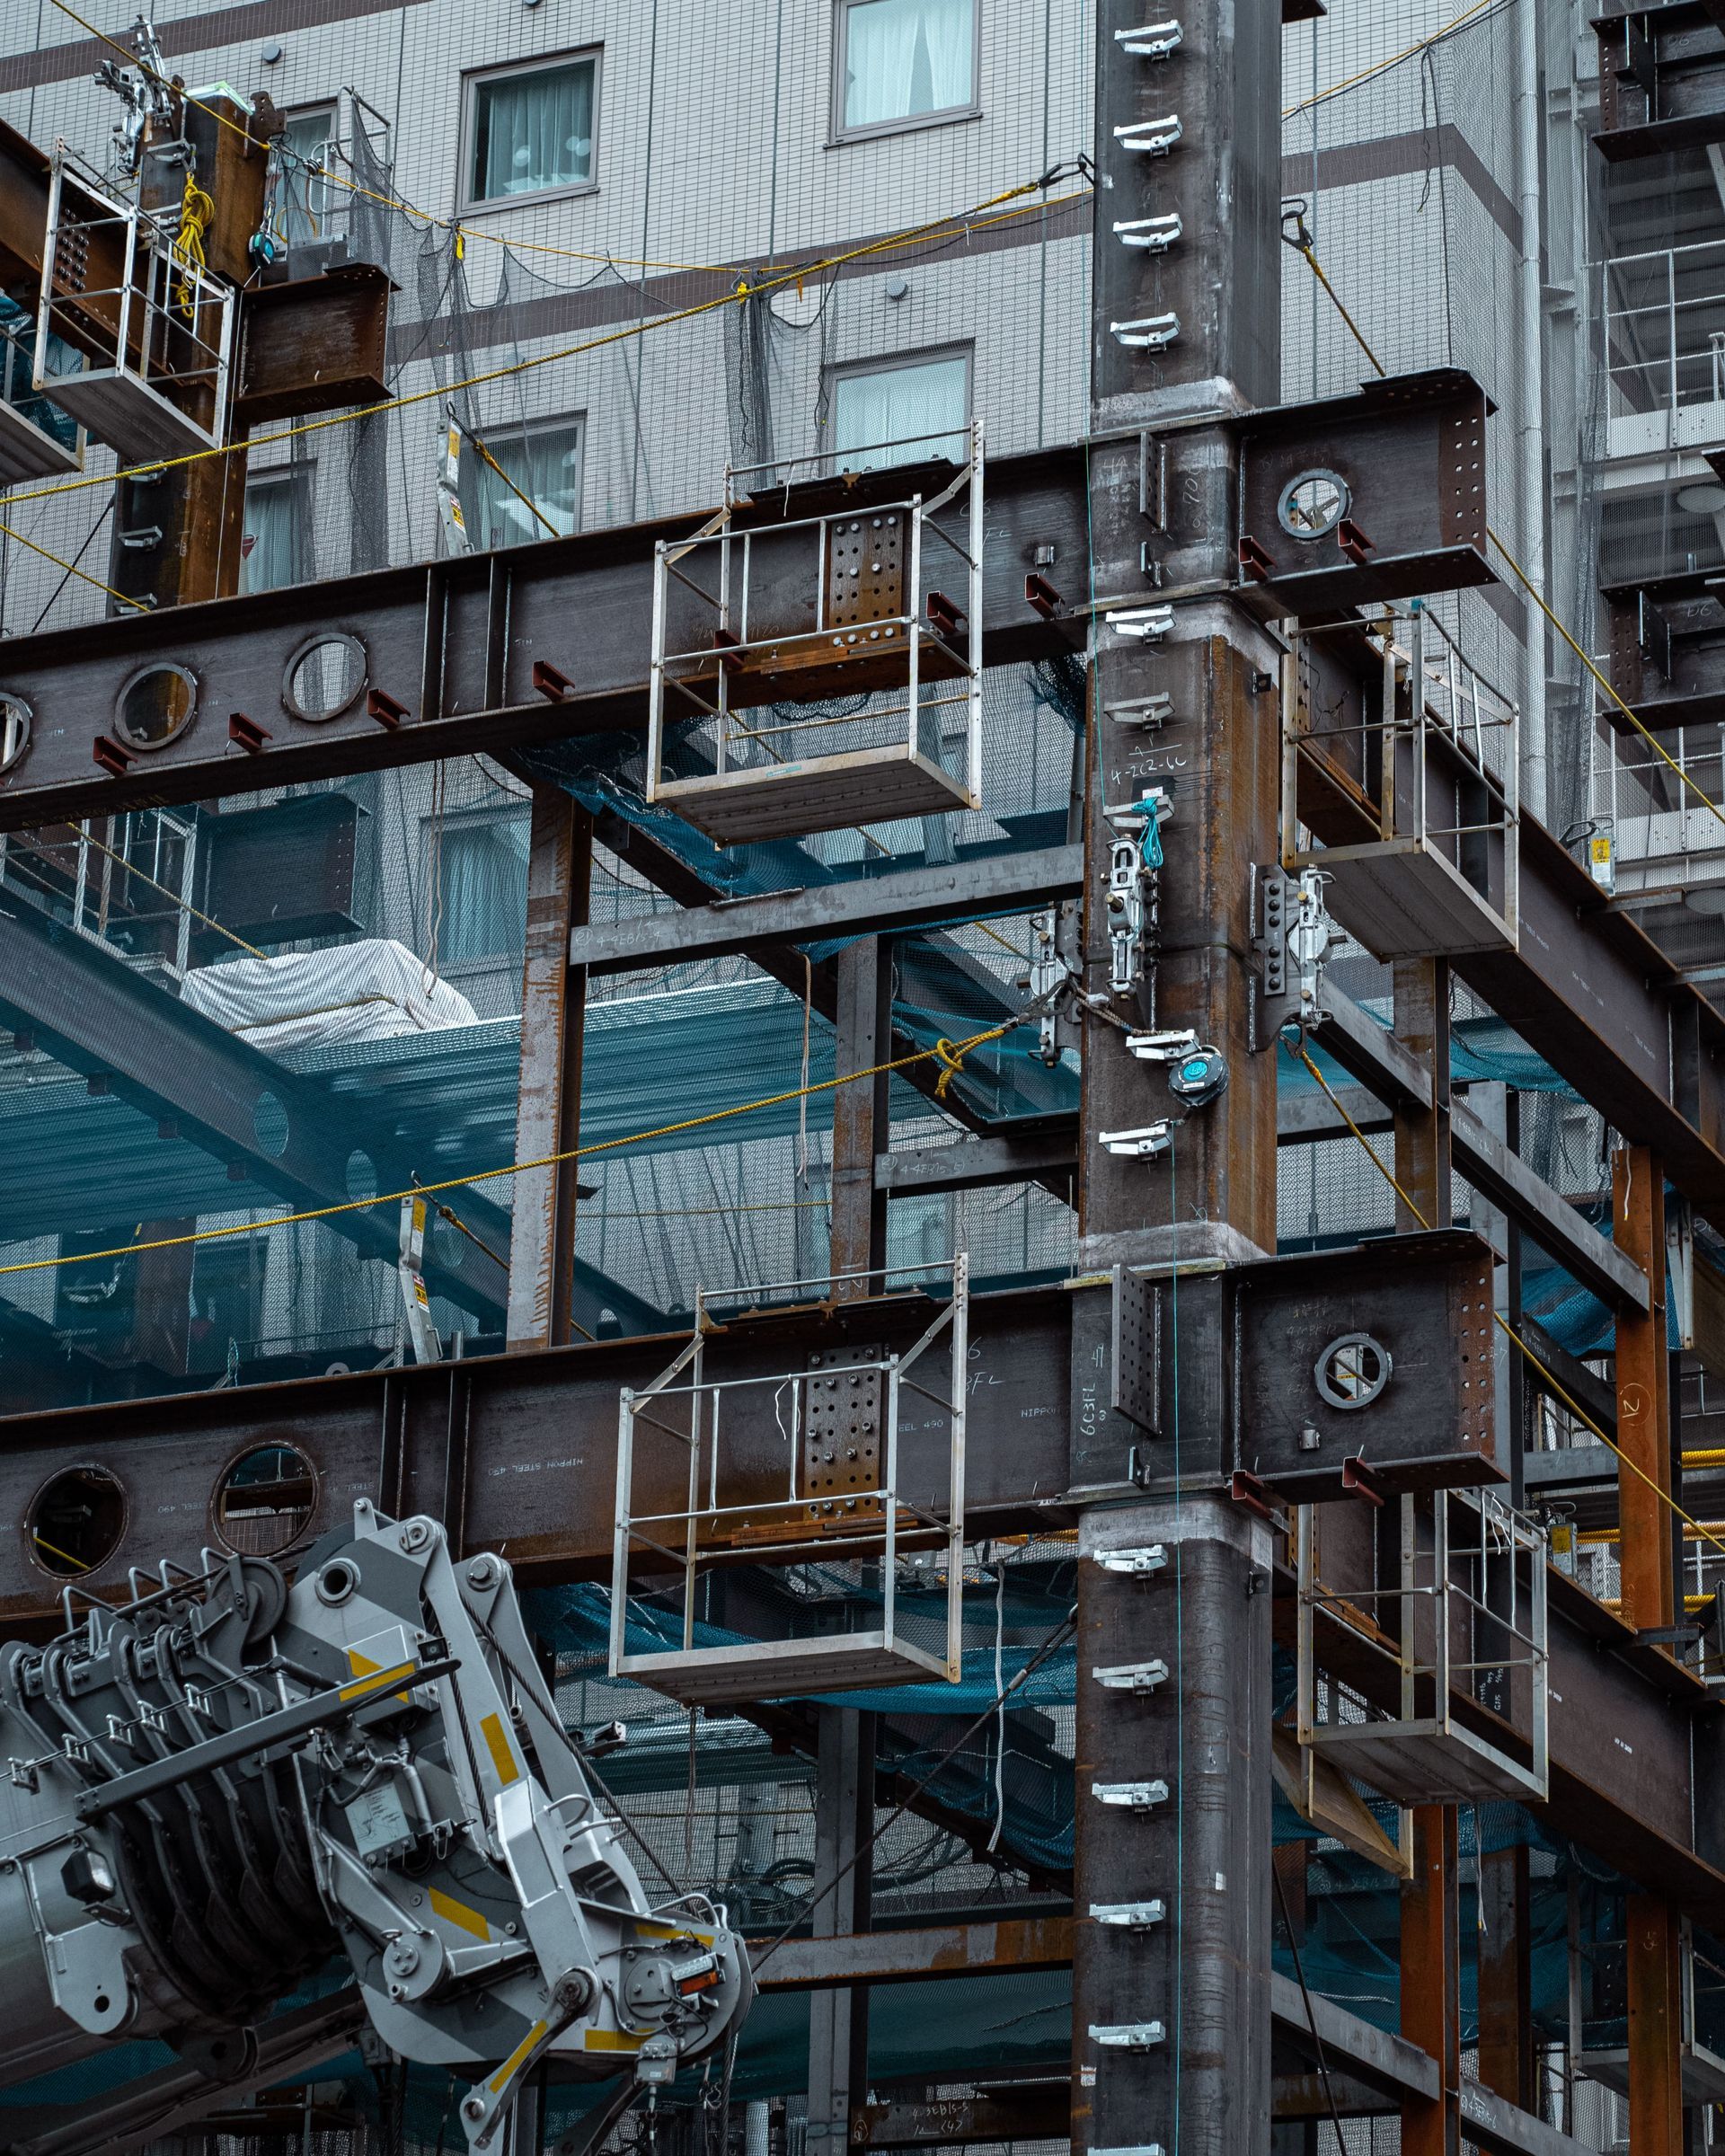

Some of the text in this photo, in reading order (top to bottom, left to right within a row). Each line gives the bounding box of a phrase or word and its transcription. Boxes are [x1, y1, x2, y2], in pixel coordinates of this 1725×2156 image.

[923, 1419, 944, 1429] 490
[512, 1463, 541, 1473] STEEL
[546, 1458, 584, 1470] NIPPON
[157, 1504, 176, 1514] 490
